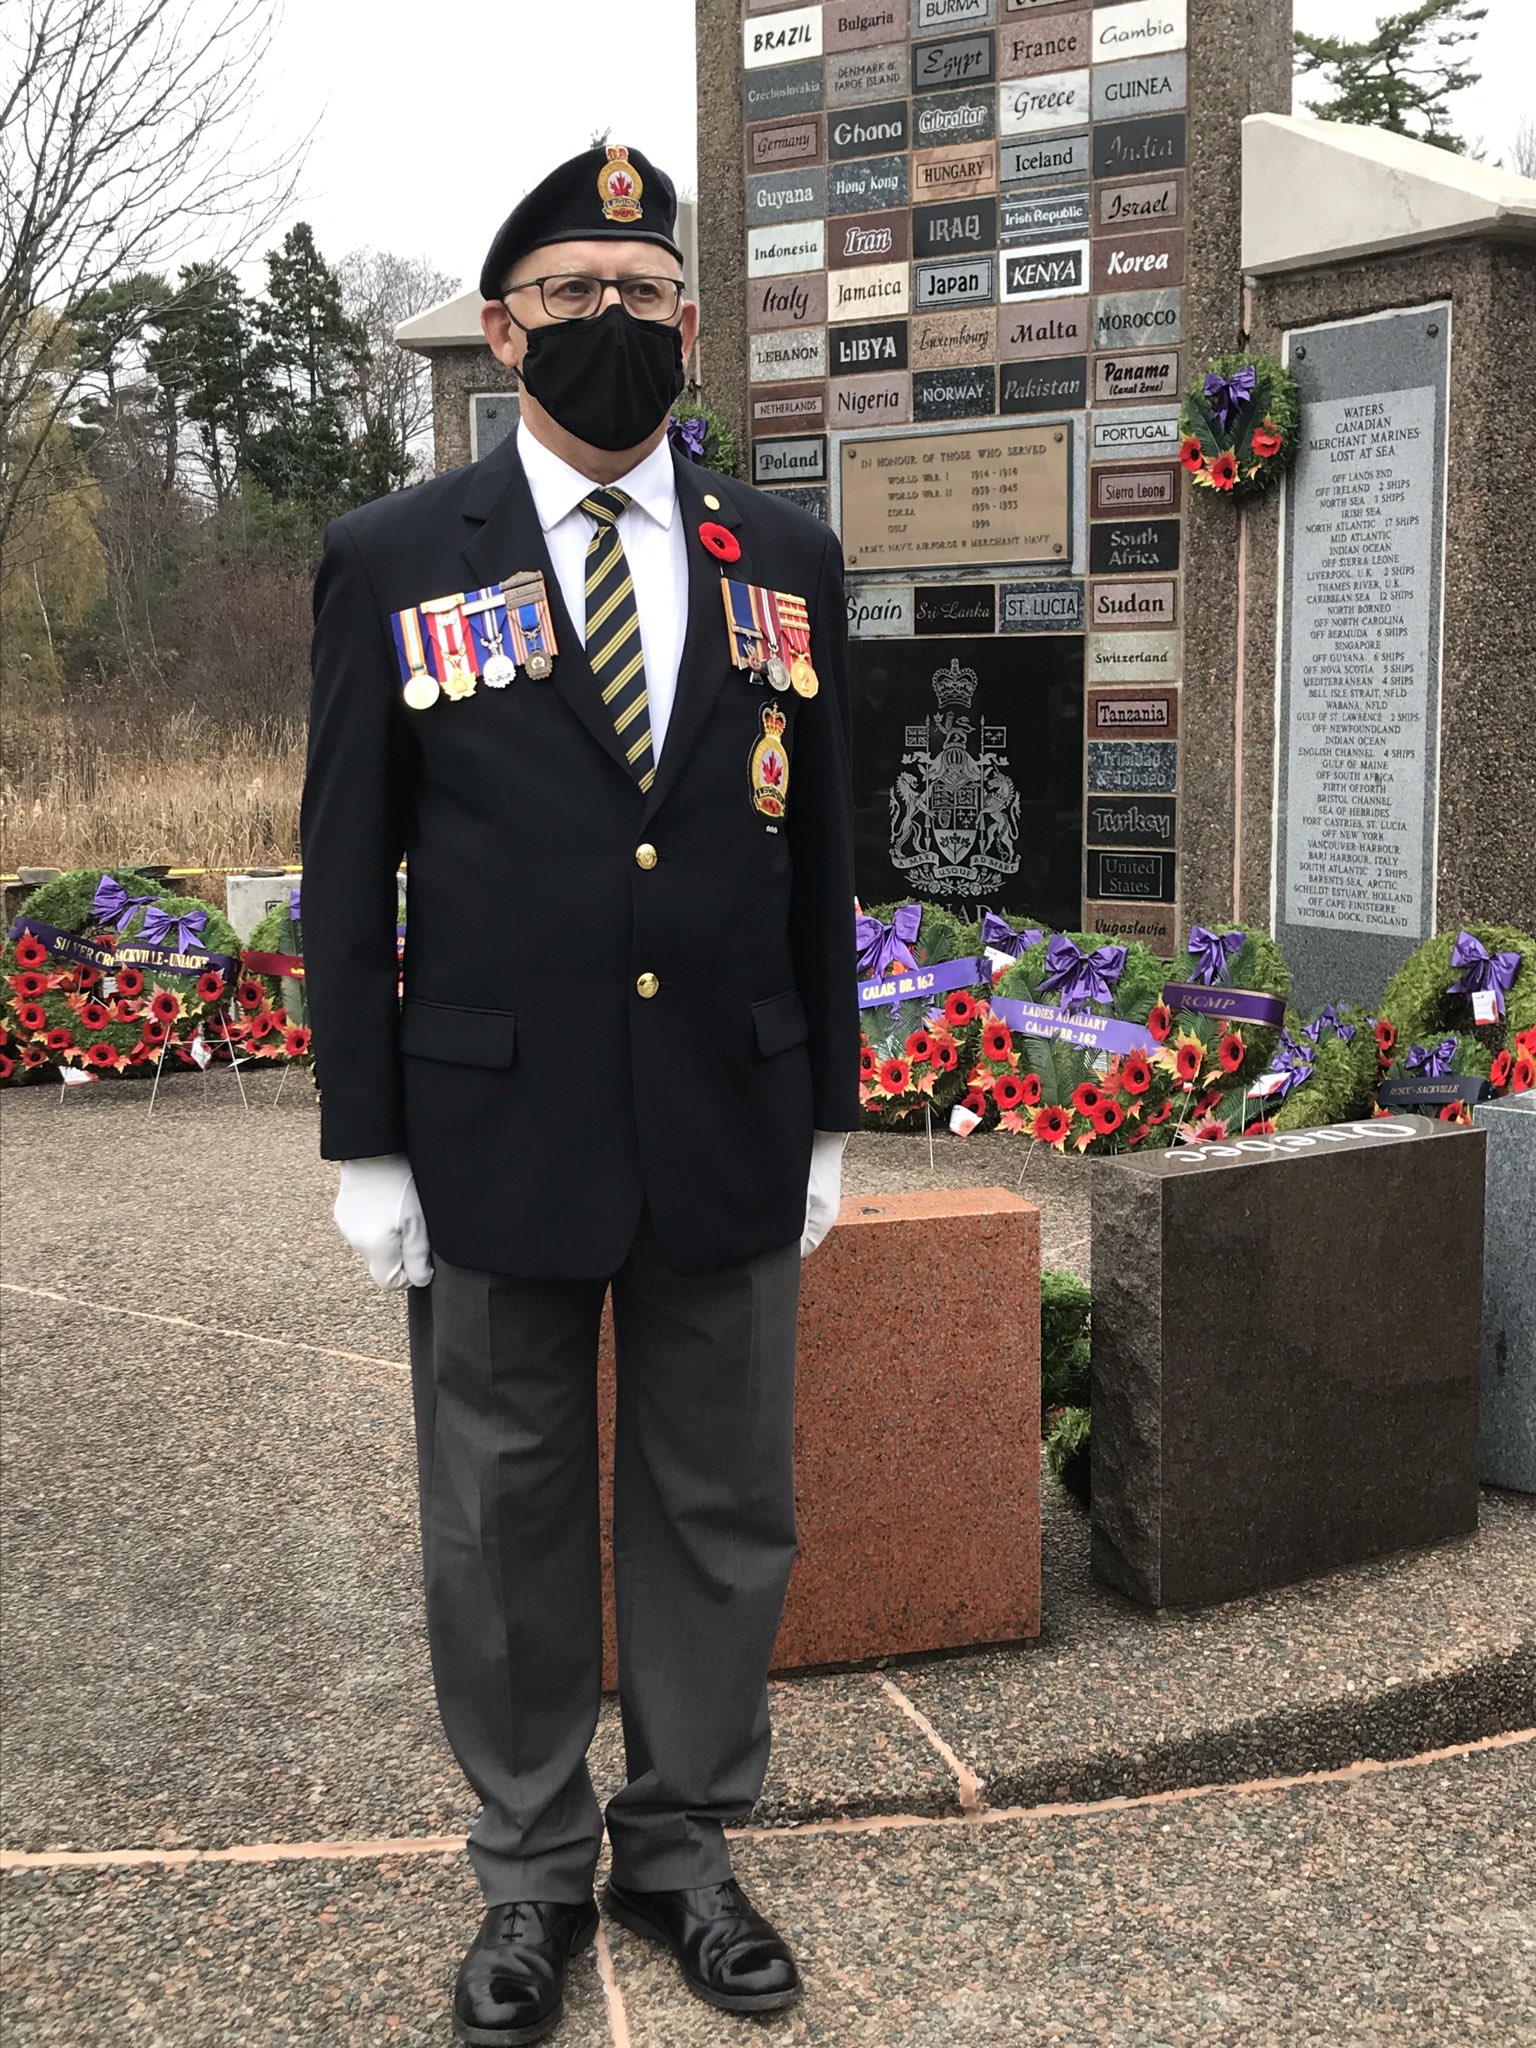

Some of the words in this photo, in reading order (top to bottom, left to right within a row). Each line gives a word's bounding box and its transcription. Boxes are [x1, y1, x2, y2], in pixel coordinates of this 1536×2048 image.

[926, 0, 980, 17] BURMA
[838, 11, 894, 33] Bulgaria
[754, 24, 812, 52] BRAZIL
[1100, 20, 1174, 44] Gambia
[1013, 36, 1076, 60] France
[839, 65, 884, 78] DENMARK
[923, 49, 982, 77] Egypt
[866, 73, 900, 87] ISLAND
[1105, 77, 1172, 100] GUINEA
[748, 82, 820, 103] Czechoslovakia
[1014, 90, 1075, 120] Greece
[919, 106, 987, 133] Gibraltar
[834, 121, 902, 145] Ghana
[757, 135, 810, 157] Germany
[1105, 136, 1173, 165] India
[1016, 148, 1073, 172] Iceland
[925, 161, 984, 182] HUNGARY
[836, 180, 865, 195] Hong
[870, 175, 898, 193] Kong
[757, 187, 813, 209] Guyana
[1108, 191, 1168, 219] Israel
[1005, 212, 1032, 225] Irish
[1034, 206, 1083, 224] Republic
[929, 215, 981, 242] IRAQ
[754, 242, 817, 260] Indonesia
[844, 227, 891, 256] Iran
[1107, 251, 1169, 275] Korea
[1013, 260, 1075, 286] KENYA
[837, 281, 902, 305] Jamaica
[928, 273, 979, 296] Japan
[763, 286, 808, 319] Italy
[1099, 309, 1176, 331] MOROCCO
[920, 325, 989, 351] Luxembourg
[1011, 320, 1078, 343] Malta
[758, 347, 818, 363] LEBANON
[840, 336, 897, 362] LIBYA
[1104, 362, 1169, 381] Panama
[923, 384, 985, 403] NORWAY
[1004, 378, 1080, 399] Pakistan
[1110, 384, 1137, 395] (Canal
[1139, 381, 1163, 394] Zone)
[760, 401, 816, 414] NETHERLANDS
[838, 389, 899, 414] Nigeria
[1344, 403, 1384, 418] WATERS
[1103, 425, 1169, 441] PORTUGAL
[1336, 417, 1391, 433] CANADIAN
[1310, 434, 1367, 450] MERCHANT
[1371, 428, 1419, 443] MARINES
[760, 450, 819, 471] Poland
[862, 459, 872, 468] IN
[877, 456, 917, 467] HONOUR
[923, 454, 934, 463] OF
[940, 450, 971, 463] THOSE
[978, 448, 1001, 458] WHO
[1008, 445, 1046, 456] SERVED
[1331, 450, 1355, 462] LOST
[1360, 448, 1372, 459] AT
[1376, 446, 1395, 457] SEA
[1333, 474, 1347, 483] OFF
[1350, 472, 1373, 481] LANDS
[1376, 469, 1392, 478] END
[1106, 485, 1133, 500] Sierra
[1138, 484, 1165, 498] Leone
[1316, 488, 1330, 496] OFF
[1333, 484, 1370, 495] IRELAND
[1379, 482, 1384, 491] 2
[1387, 480, 1410, 490] SHIPS
[1306, 524, 1332, 533] NORTH
[1335, 520, 1375, 531] ATLANTIC
[1385, 518, 1393, 527] 17
[1396, 516, 1419, 526] SHIPS
[1111, 528, 1158, 547] South
[1109, 549, 1159, 566] Africa
[847, 596, 902, 629] Spain
[916, 603, 937, 621] Sri
[941, 601, 991, 619] Lanka
[1008, 601, 1028, 616] ST.
[1034, 599, 1075, 615] LUCIA
[1098, 593, 1164, 613] Sudan
[1328, 606, 1354, 615] NORTH
[1358, 604, 1391, 613] BORNEO
[1314, 619, 1328, 627] OFF
[1332, 617, 1358, 626] NORTH
[1362, 616, 1404, 625] CAROLINA
[1311, 631, 1325, 639] OFF
[1328, 630, 1367, 638] BERMUDA
[1385, 628, 1408, 637] SHIPS
[1335, 641, 1381, 650] SINGAPORE
[1095, 651, 1168, 663] Switzerland
[1100, 704, 1165, 723] Tanzania
[1313, 725, 1327, 733] OFF
[1330, 725, 1401, 734] NEWFOUNDLAND
[1325, 737, 1354, 745] INDIAN
[1358, 737, 1386, 745] OCEAN
[1101, 751, 1160, 768] Trinidad
[1322, 760, 1344, 768] GULF
[1347, 760, 1356, 768] OF
[1361, 761, 1388, 769] MAINE
[1317, 795, 1348, 804] BRISTOL
[1352, 796, 1392, 806] CHANNEL
[1319, 806, 1332, 814] SEA
[1337, 807, 1346, 816] OF
[1350, 808, 1389, 817] HEBRIDES
[1093, 806, 1170, 838] Turkey
[1322, 830, 1336, 838] OFF
[1340, 831, 1358, 839] NEW
[1363, 832, 1384, 841] YORK
[1308, 840, 1356, 851] VANCOUVER
[1360, 843, 1399, 853] HARBOUR
[940, 868, 972, 877] USQUE
[1106, 859, 1155, 875] United
[1110, 878, 1150, 893] States
[1309, 897, 1323, 906] OFF
[1326, 900, 1345, 908] CAPE
[1349, 901, 1396, 913] FINISTERRE
[115, 949, 163, 965] SACKVILLE
[863, 982, 896, 1000] CALAIS
[900, 979, 915, 993] BR.
[917, 973, 934, 989] 162
[1181, 995, 1235, 1009] RCMP
[1023, 1005, 1054, 1020] LADIES
[1416, 1085, 1460, 1093] SACKVILLE
[1164, 1123, 1417, 1162] Quebec
